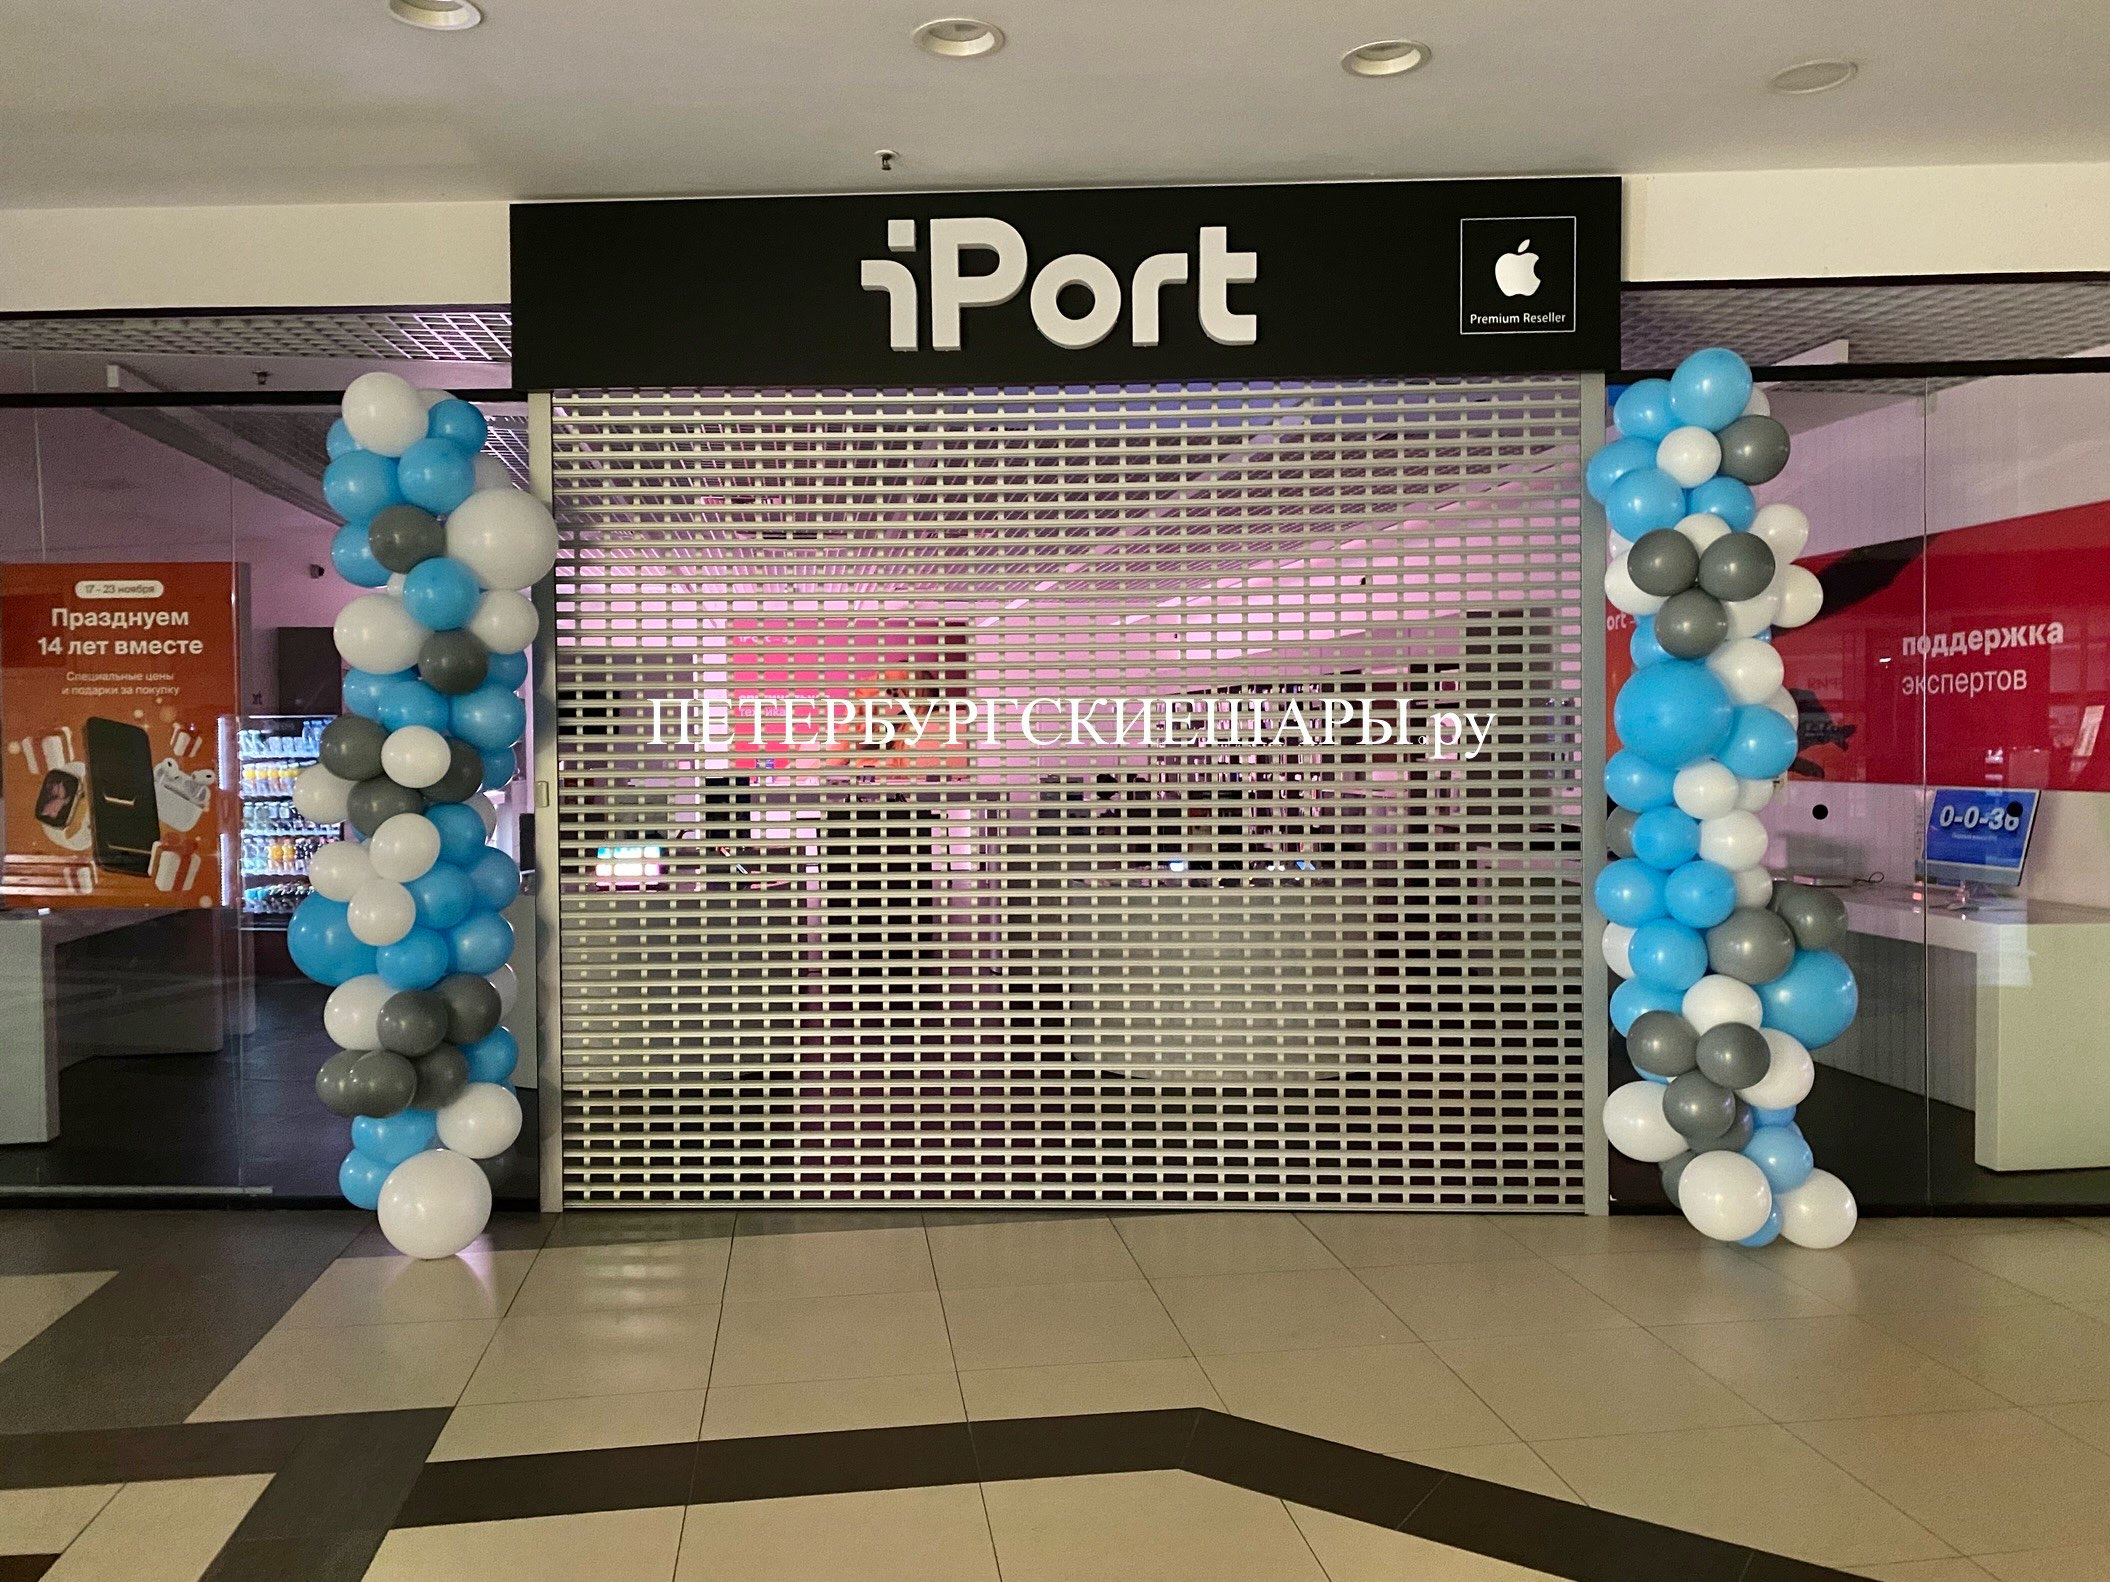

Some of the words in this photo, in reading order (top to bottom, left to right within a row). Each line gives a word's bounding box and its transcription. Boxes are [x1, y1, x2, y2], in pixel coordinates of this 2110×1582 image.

[861, 217, 1258, 352] iPort
[1470, 313, 1520, 324] Premium
[1523, 312, 1566, 323] Reseller
[85, 584, 95, 594] 17
[103, 584, 116, 594] 23
[118, 584, 155, 595] ноября
[52, 608, 189, 631] Празднуем
[37, 637, 63, 656] 14
[67, 640, 109, 655] лет
[114, 639, 204, 655] вместе
[1902, 621, 2064, 658] поддержка
[66, 671, 143, 682] Специальные
[145, 672, 174, 683] цены
[1902, 669, 2027, 698] экспертов
[62, 687, 69, 695] и
[71, 687, 119, 696] подарки
[120, 686, 133, 695] за
[135, 686, 180, 696] покупку
